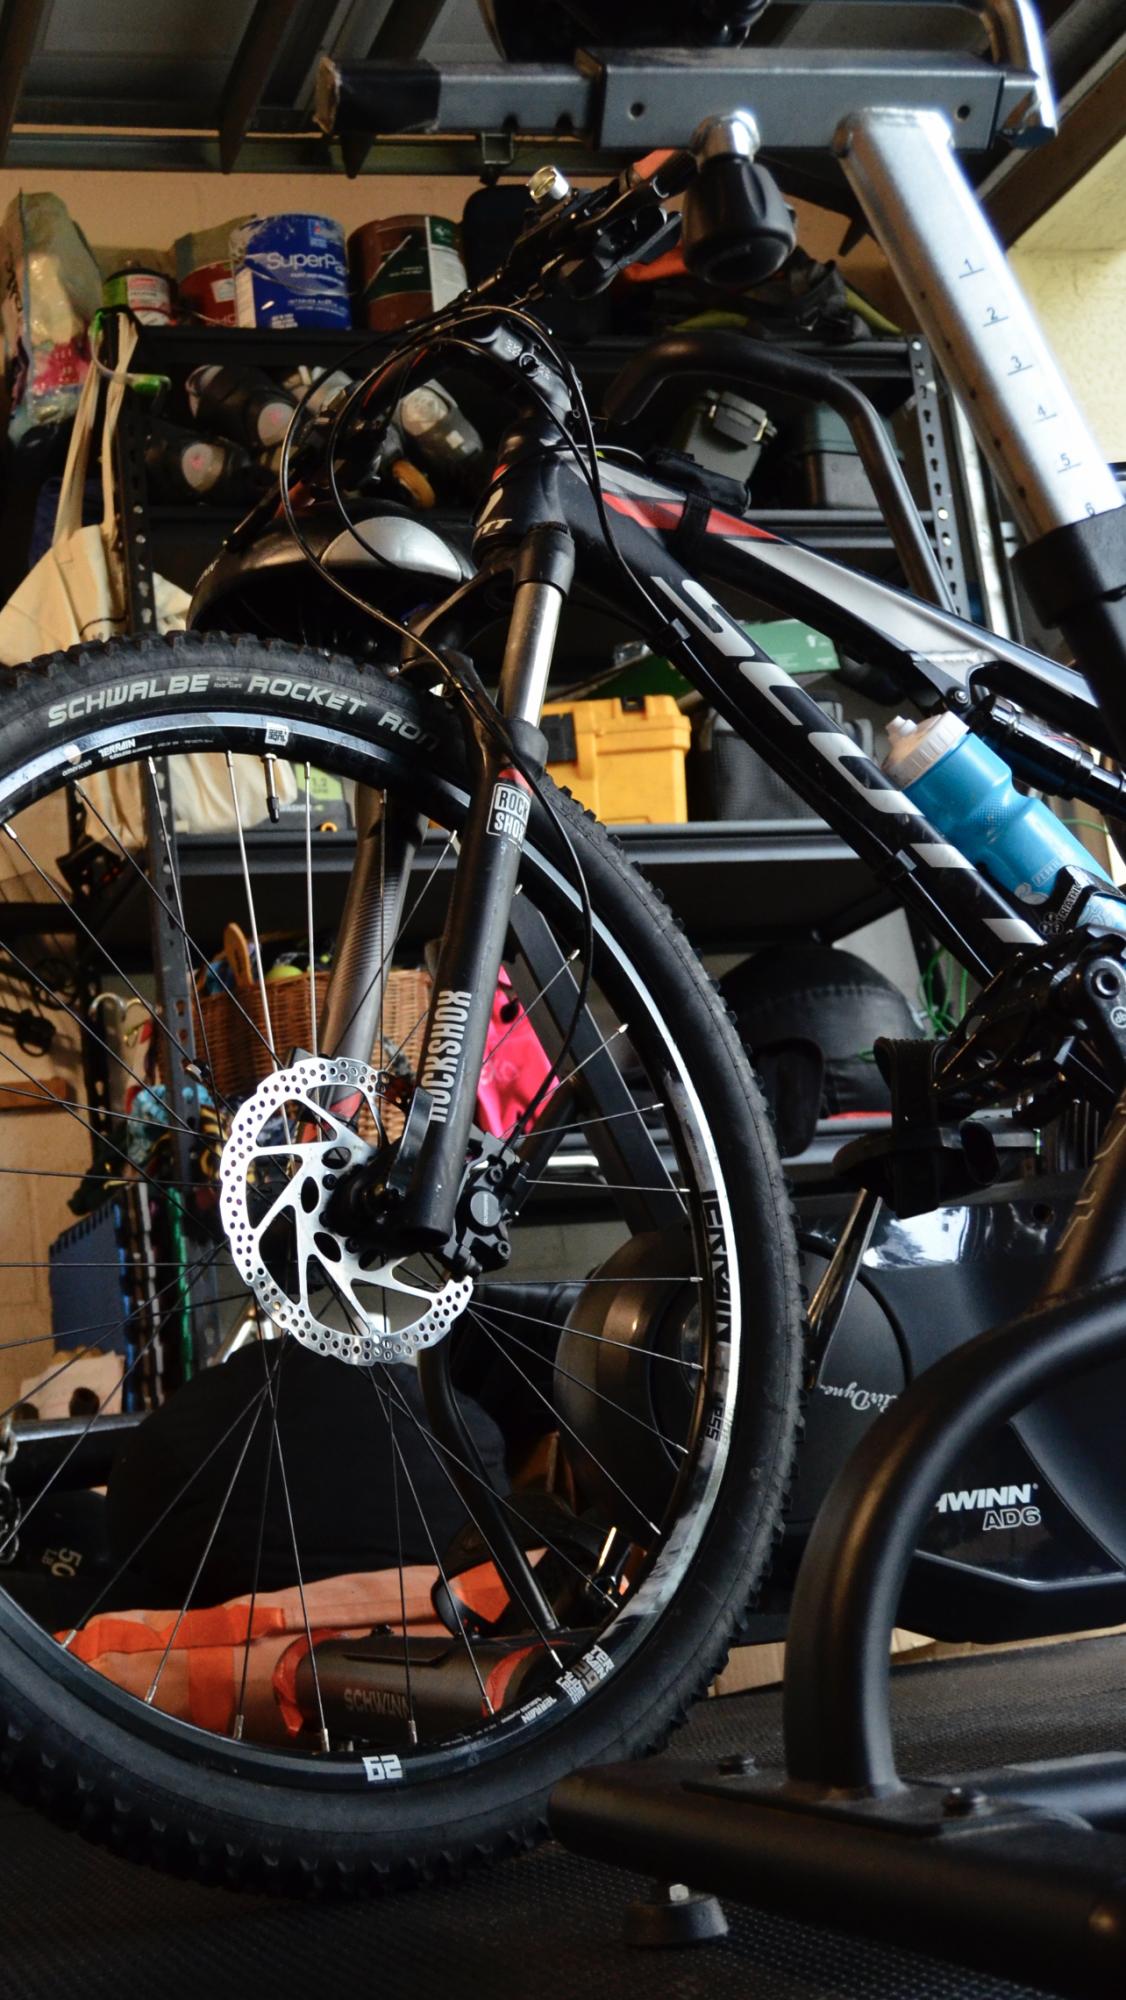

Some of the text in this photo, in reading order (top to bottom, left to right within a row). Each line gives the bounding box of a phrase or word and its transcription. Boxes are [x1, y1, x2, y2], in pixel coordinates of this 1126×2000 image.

[963, 259, 973, 273] 1
[986, 306, 999, 322] 2
[1010, 355, 1022, 370] 3
[1036, 404, 1047, 417] 4
[1060, 452, 1071, 467] 5
[48, 674, 210, 728] SCHWALBE
[247, 676, 368, 716] ROCKET
[982, 1506, 1042, 1531] AD6
